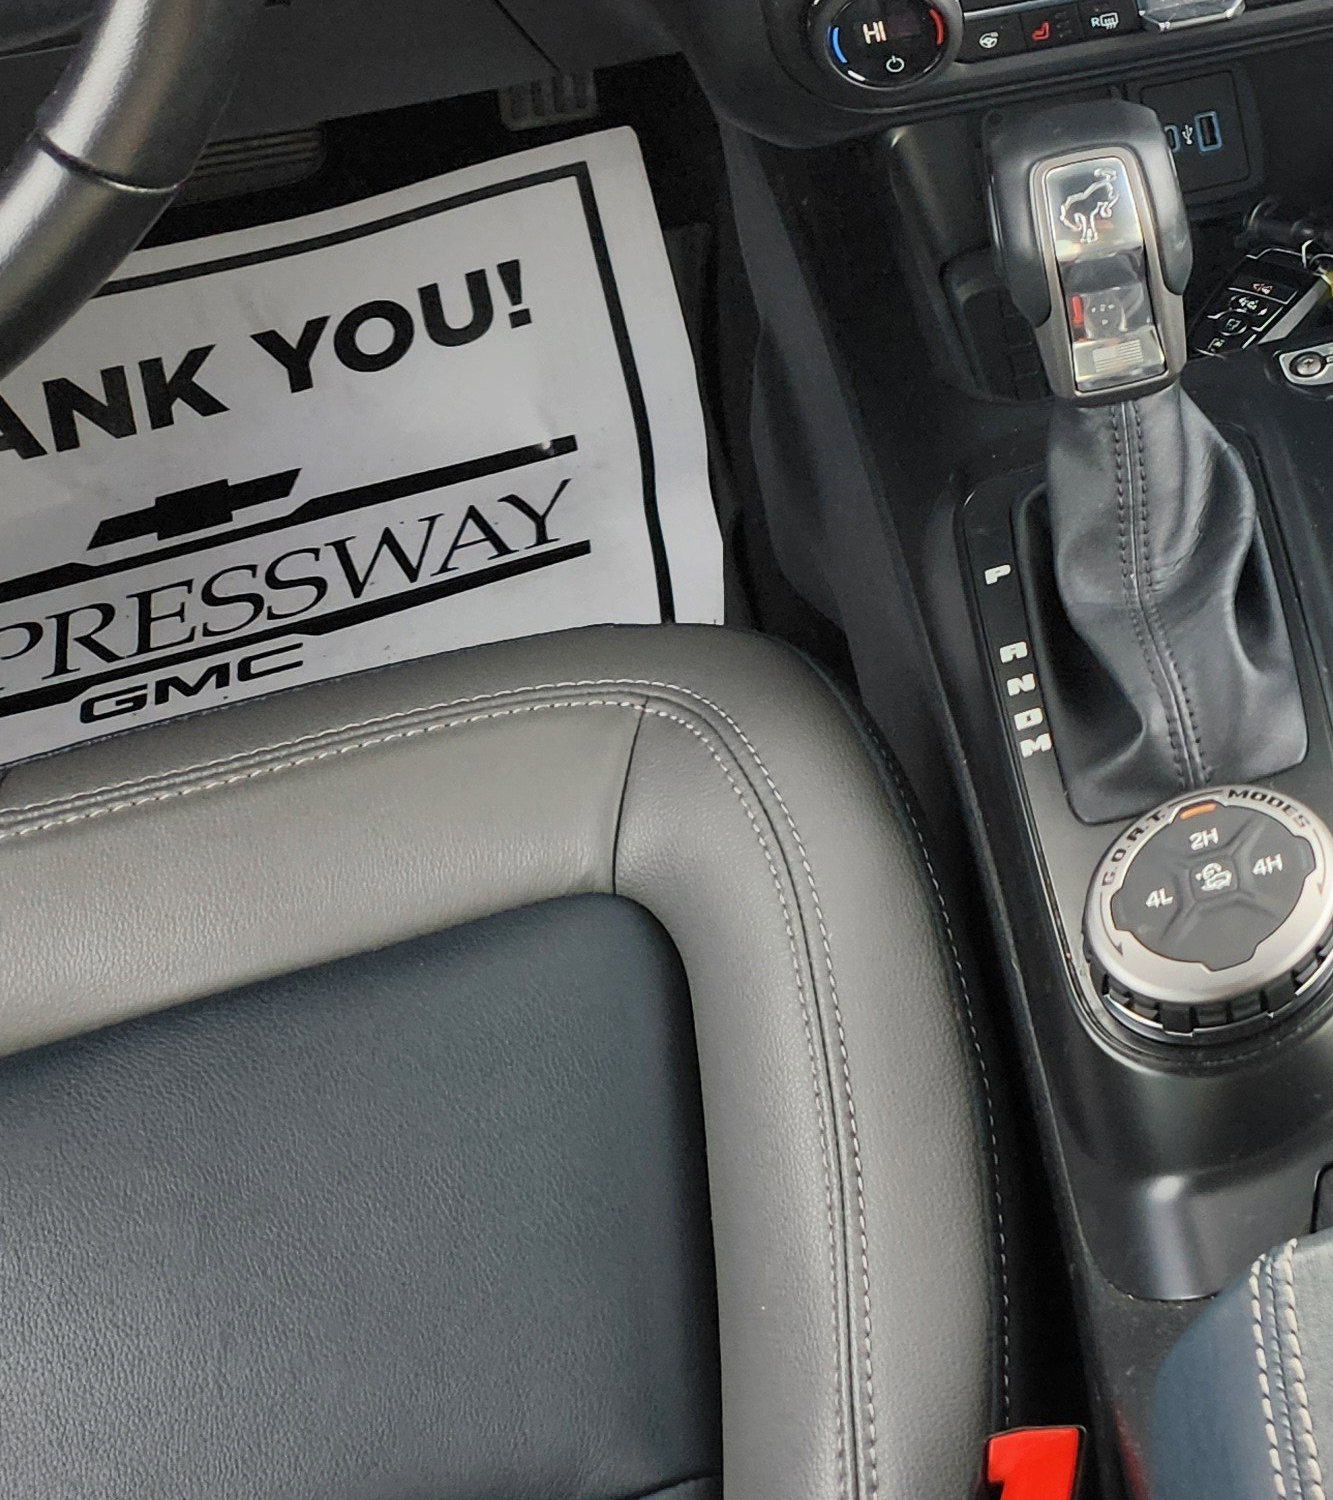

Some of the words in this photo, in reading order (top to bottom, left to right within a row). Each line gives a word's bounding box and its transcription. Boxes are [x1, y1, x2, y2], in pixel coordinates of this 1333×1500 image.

[862, 20, 887, 44] HI
[251, 259, 532, 394] YOU!
[984, 563, 1011, 586] P
[1000, 640, 1028, 664] R
[79, 642, 303, 725] GMC
[1007, 673, 1036, 696] N
[1014, 707, 1044, 730] D
[1019, 732, 1053, 758] M
[1227, 787, 1312, 829] MODES
[1189, 827, 1220, 851] 2H
[1252, 853, 1284, 877] 4H
[1145, 887, 1174, 910] 4L
